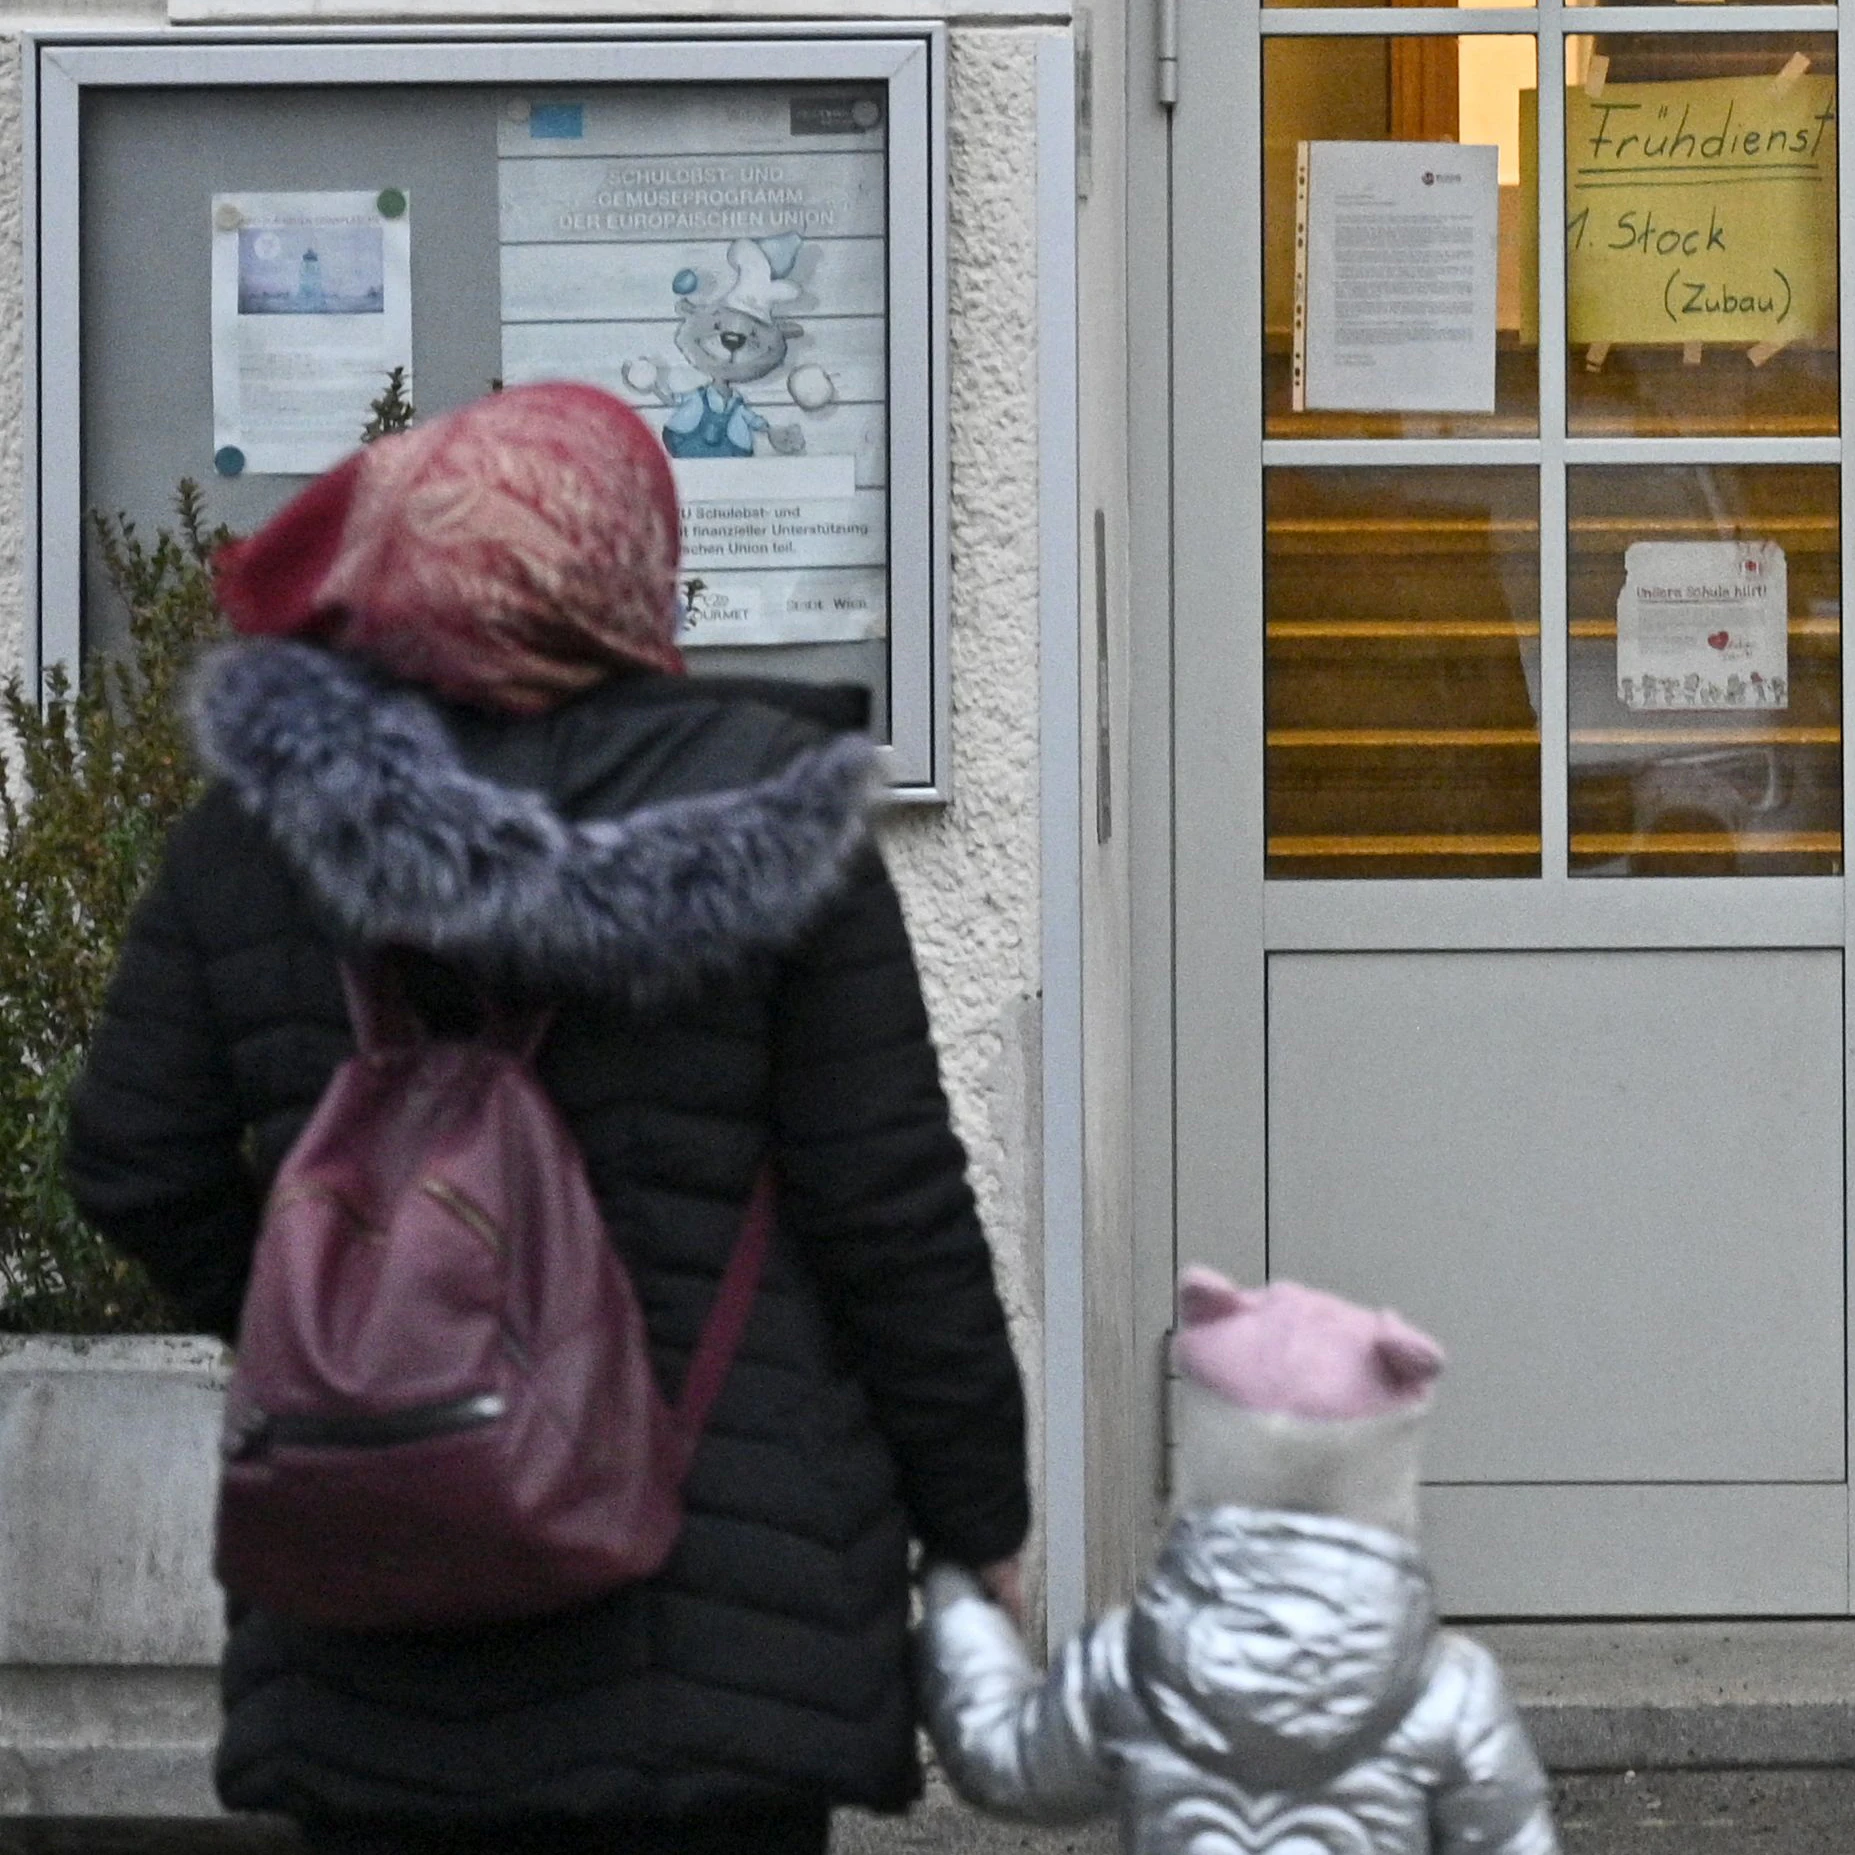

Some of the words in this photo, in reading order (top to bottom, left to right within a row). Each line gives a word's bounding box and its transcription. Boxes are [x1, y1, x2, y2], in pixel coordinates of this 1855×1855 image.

[1588, 95, 1835, 159] Frühdienst
[740, 166, 784, 183] UND
[559, 213, 600, 230] DER
[770, 209, 835, 226] UNION
[1567, 207, 1594, 250] 1.
[1607, 206, 1727, 254] Stock
[1664, 268, 1792, 324] (Zubau)
[774, 506, 801, 519] und
[692, 523, 767, 537] finanzieller
[771, 522, 869, 537] Unterstützung
[728, 541, 769, 555] Union
[833, 597, 868, 611] Wien
